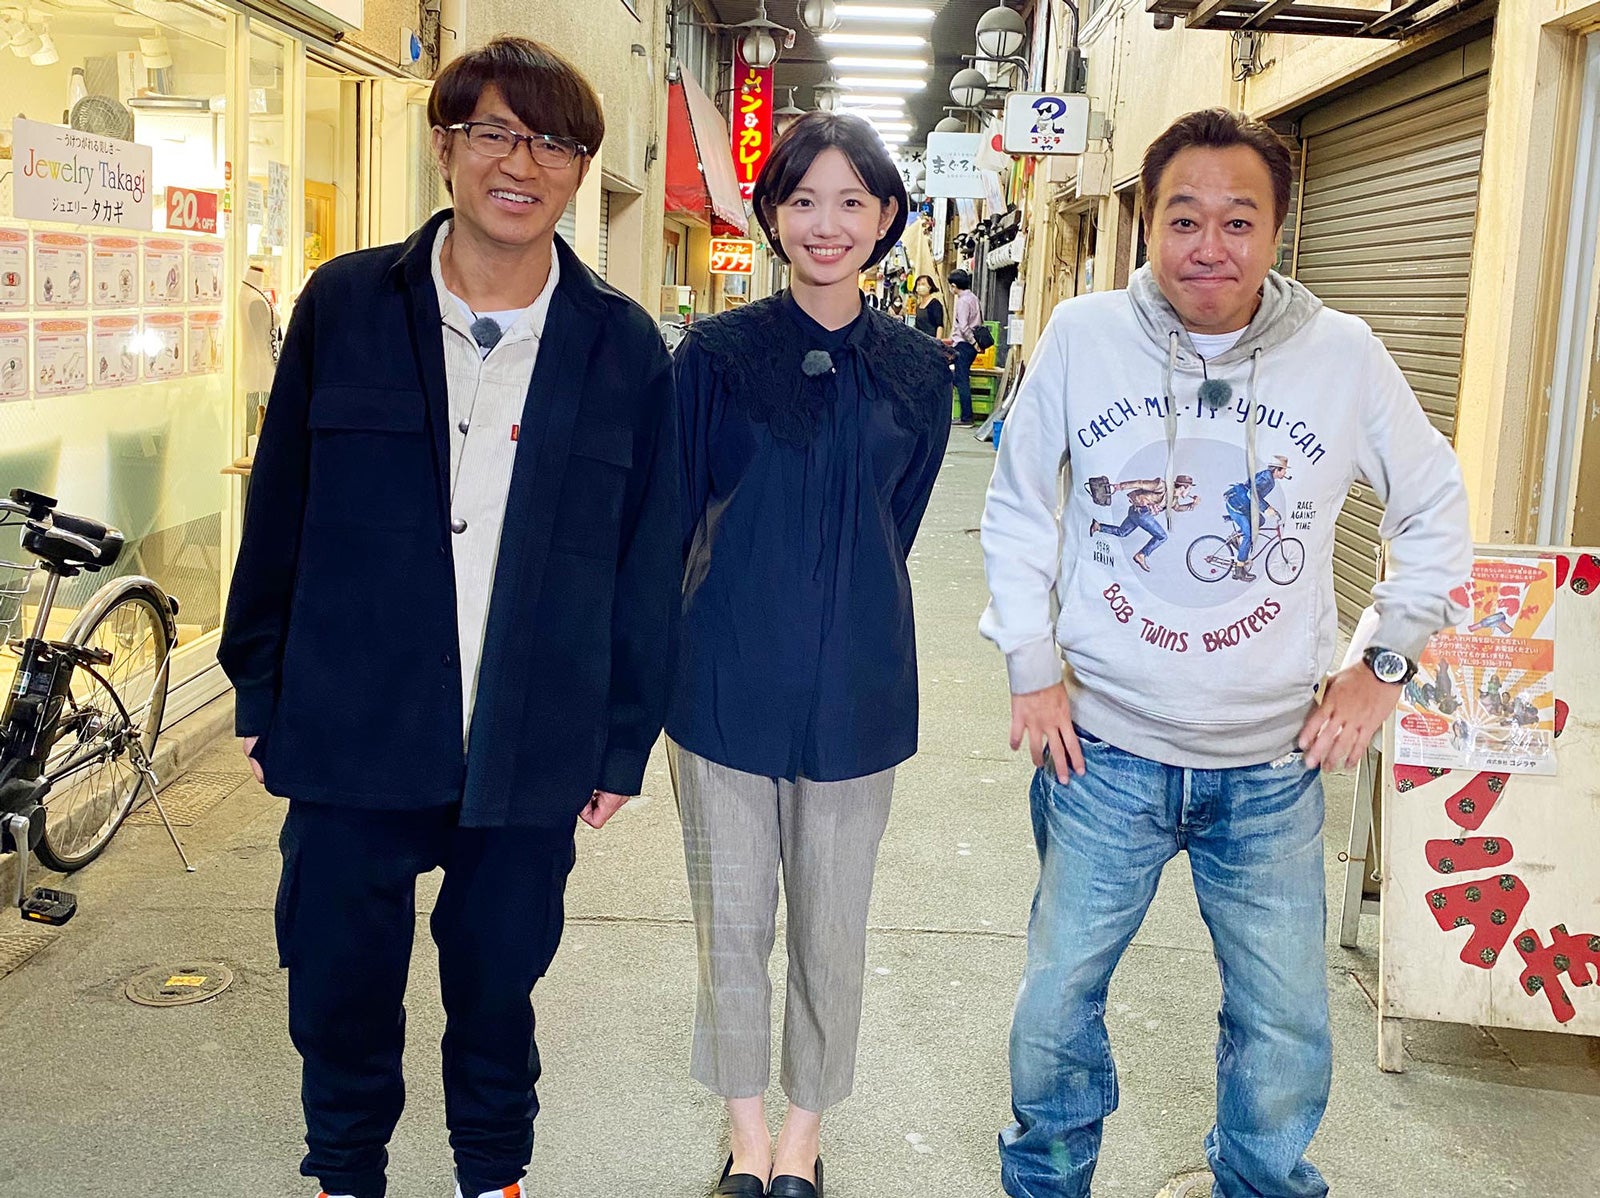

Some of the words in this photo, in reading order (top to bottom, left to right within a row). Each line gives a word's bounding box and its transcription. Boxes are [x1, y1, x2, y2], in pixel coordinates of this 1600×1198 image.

[23, 148, 94, 195] Jewelry
[99, 161, 146, 203] Takagi
[52, 198, 88, 214] ジュエリー
[91, 199, 124, 223] タカギ
[1236, 398, 1284, 429] YOU
[1290, 510, 1317, 520] AGAINST
[1295, 521, 1311, 531] TIME
[1093, 550, 1115, 568] BERLIN
[1103, 582, 1134, 624] BOB
